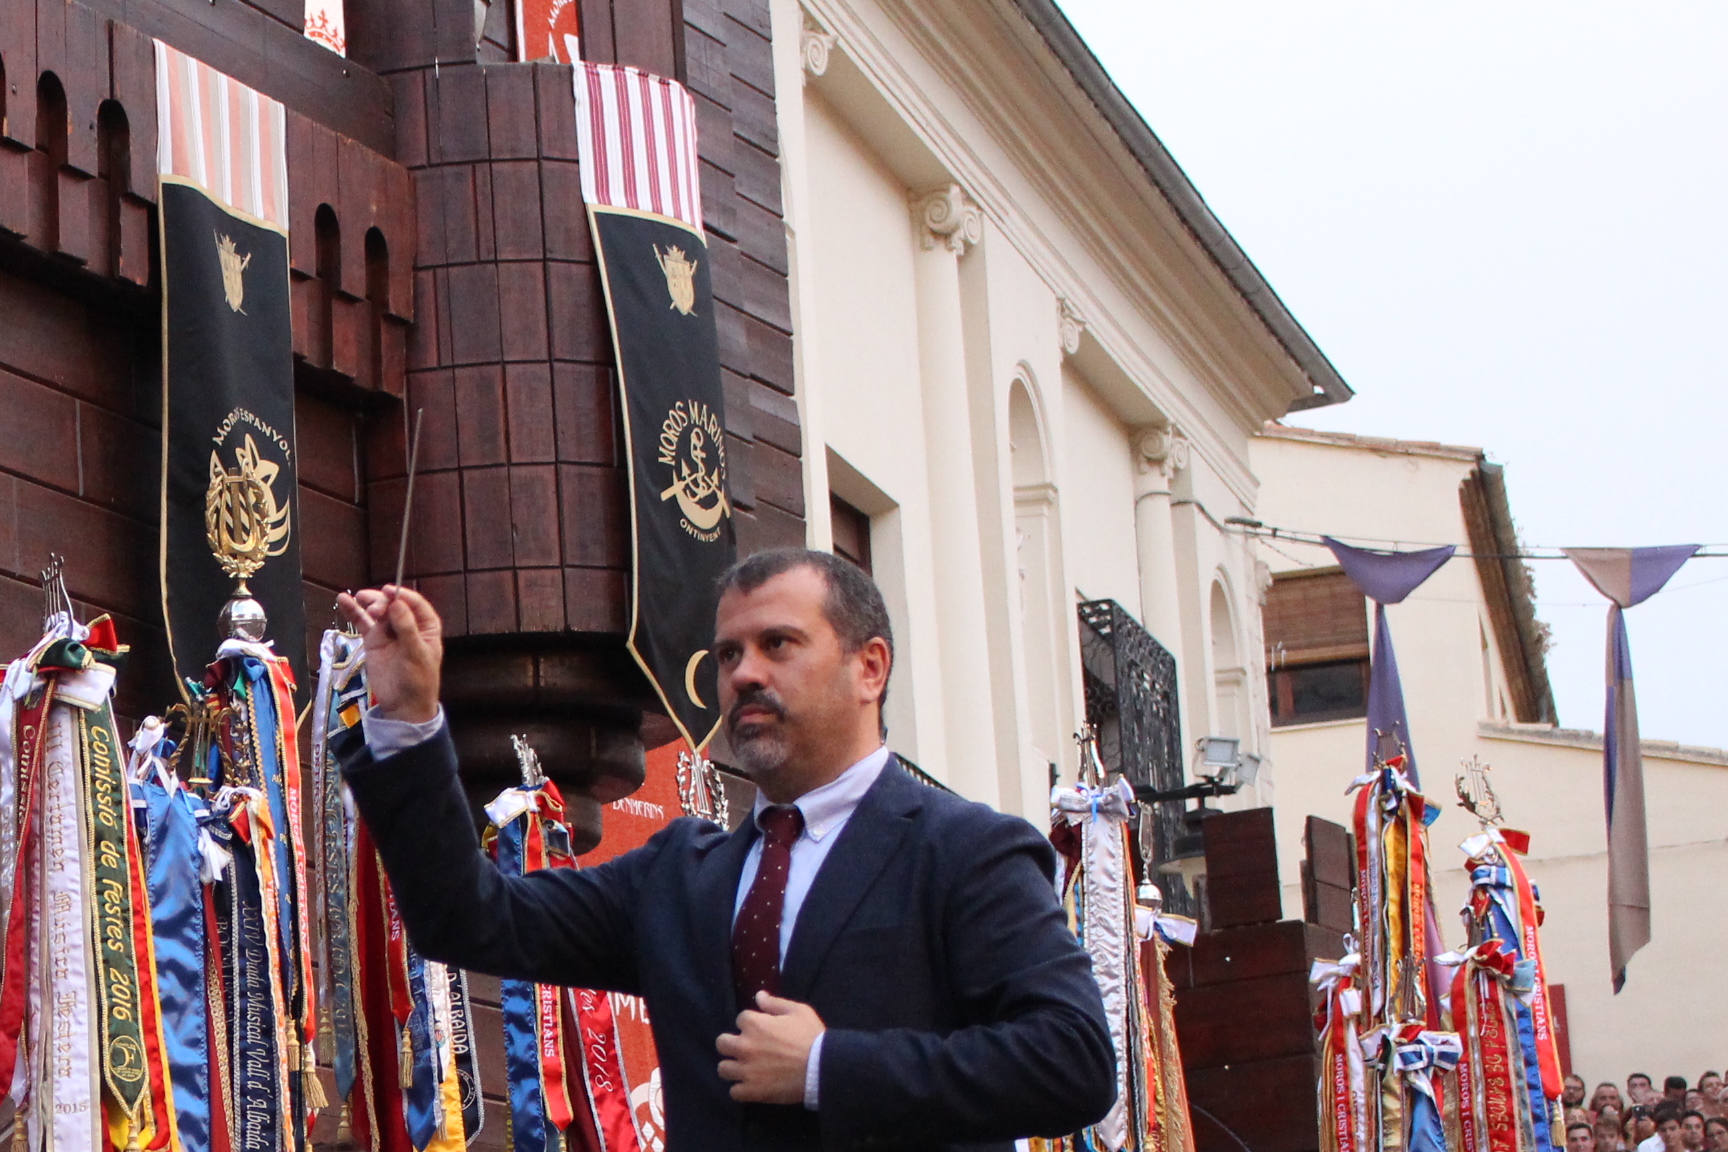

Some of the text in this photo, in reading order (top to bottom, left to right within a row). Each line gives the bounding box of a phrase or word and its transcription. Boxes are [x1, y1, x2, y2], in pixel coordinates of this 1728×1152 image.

[658, 401, 689, 466] MOROS
[679, 518, 721, 543] ONTINYENT
[90, 725, 118, 829] Comissió
[47, 763, 65, 872] Certamen
[289, 787, 303, 845] MOROS
[100, 842, 118, 869] de
[102, 878, 124, 952] Festes
[242, 900, 264, 945] XXIV
[109, 967, 132, 1021] 2016
[245, 948, 263, 988] Diada
[247, 992, 268, 1045] Musical
[542, 984, 556, 1058] CRISTIANS
[247, 1048, 270, 1078] Vall
[586, 1027, 614, 1092] 2018
[1335, 1053, 1346, 1093] MOROS
[1460, 1063, 1472, 1109] MOROS
[1485, 1054, 1504, 1072] DE
[54, 1102, 88, 1115] 2015
[1487, 1078, 1508, 1132] BANDES
